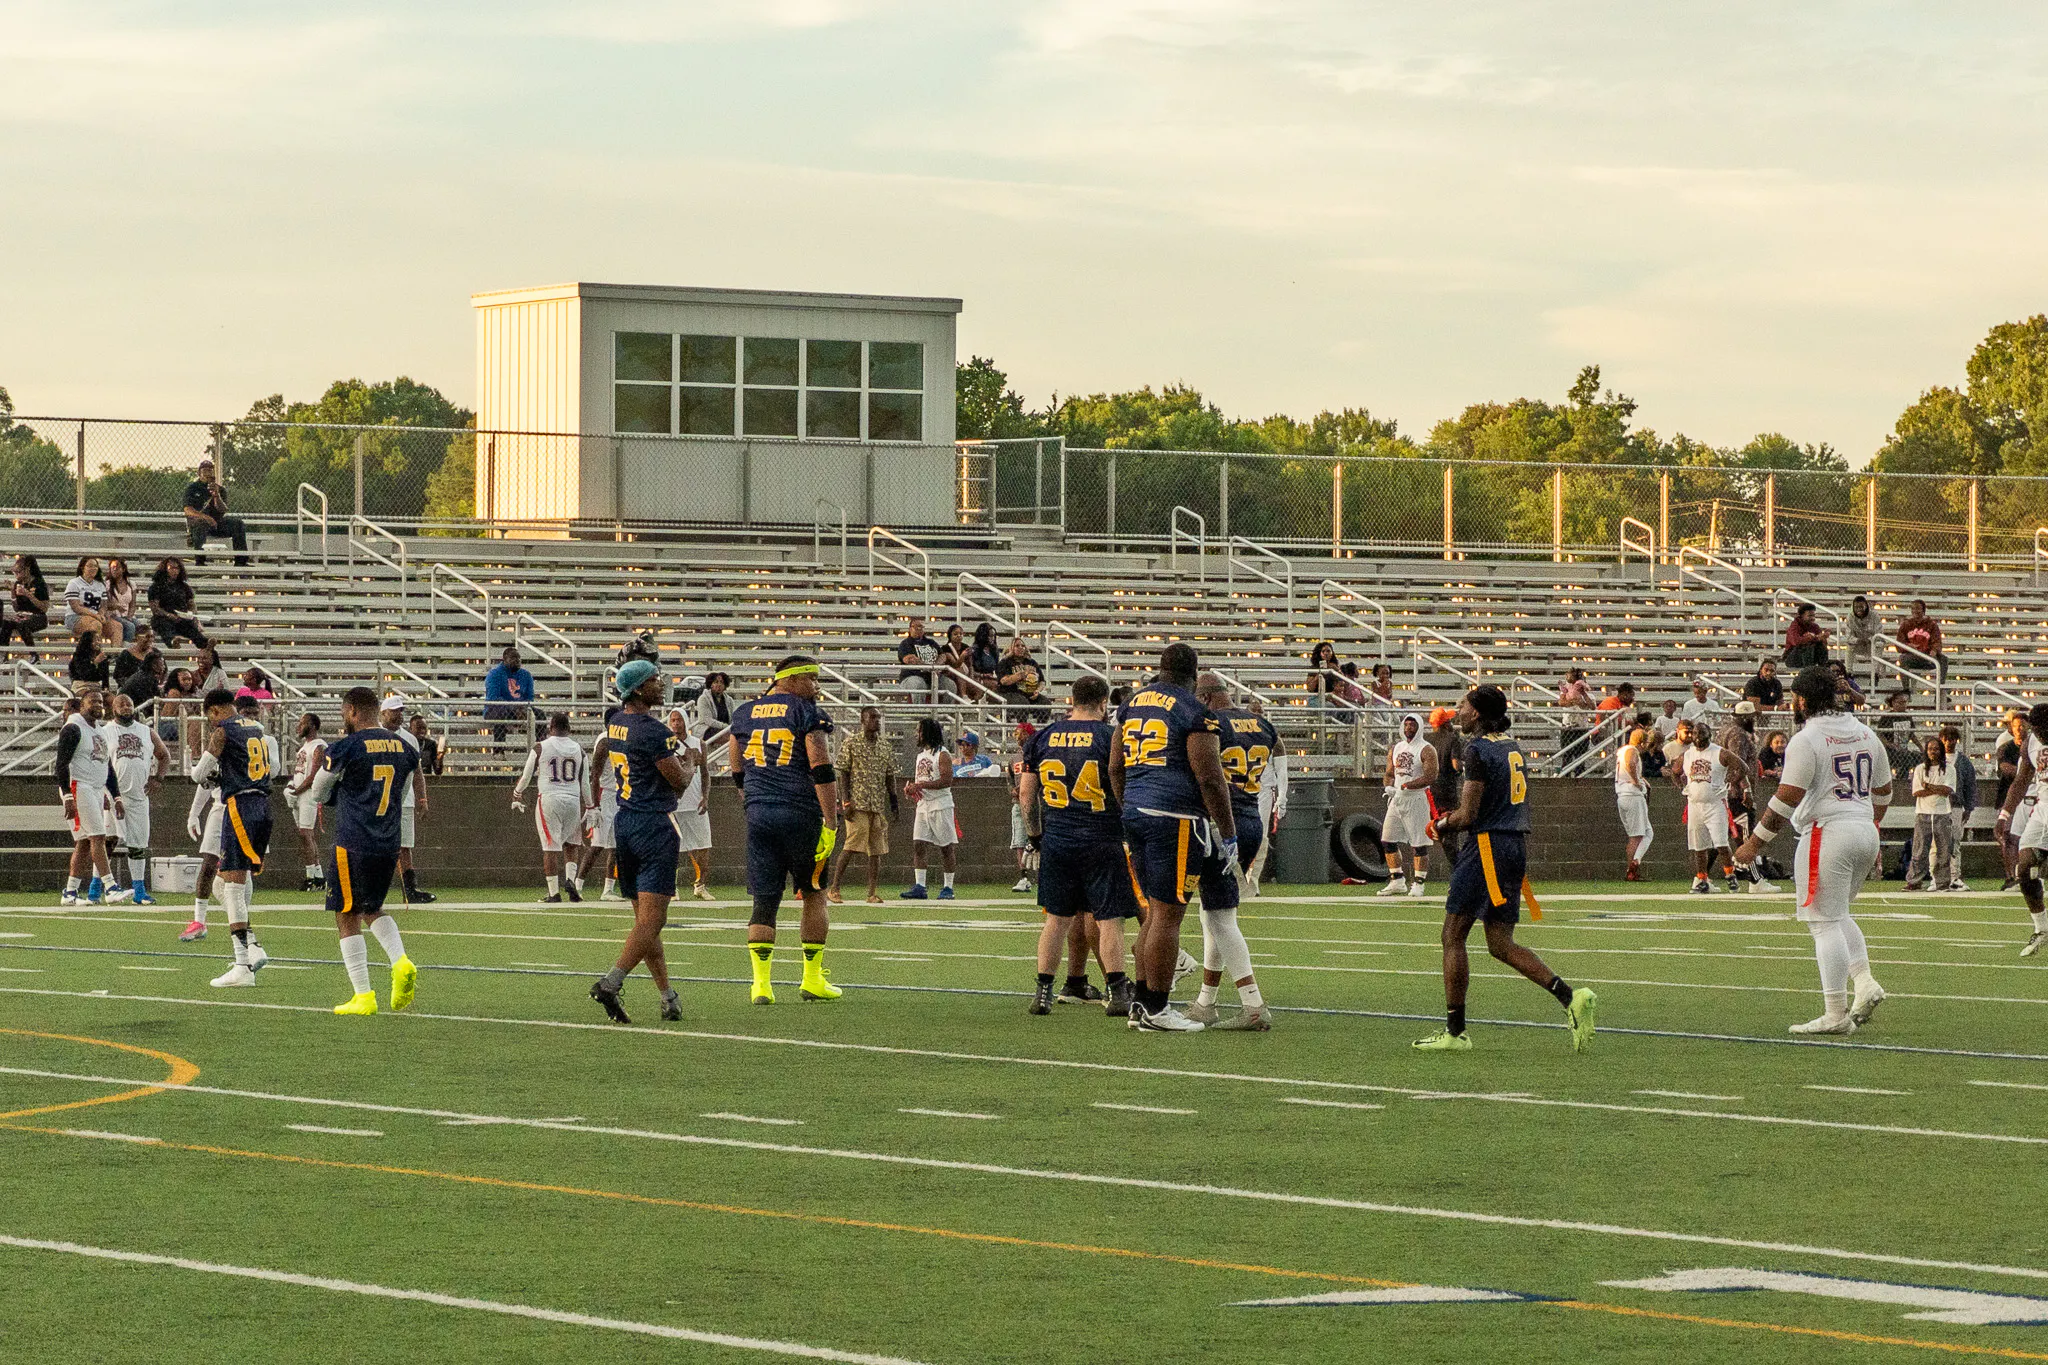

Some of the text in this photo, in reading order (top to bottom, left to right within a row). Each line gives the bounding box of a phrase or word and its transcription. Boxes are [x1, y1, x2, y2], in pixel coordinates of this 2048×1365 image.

[1129, 691, 1177, 711] THOMAS
[1230, 718, 1262, 733] COOK
[743, 728, 795, 767] 47
[1048, 732, 1094, 748] GATES
[1122, 718, 1168, 767] 52
[373, 764, 395, 816] 7
[549, 757, 577, 783] 10
[1038, 759, 1106, 812] 64
[1221, 745, 1270, 794] 22
[1508, 751, 1527, 805] 6
[1831, 750, 1874, 802] 50
